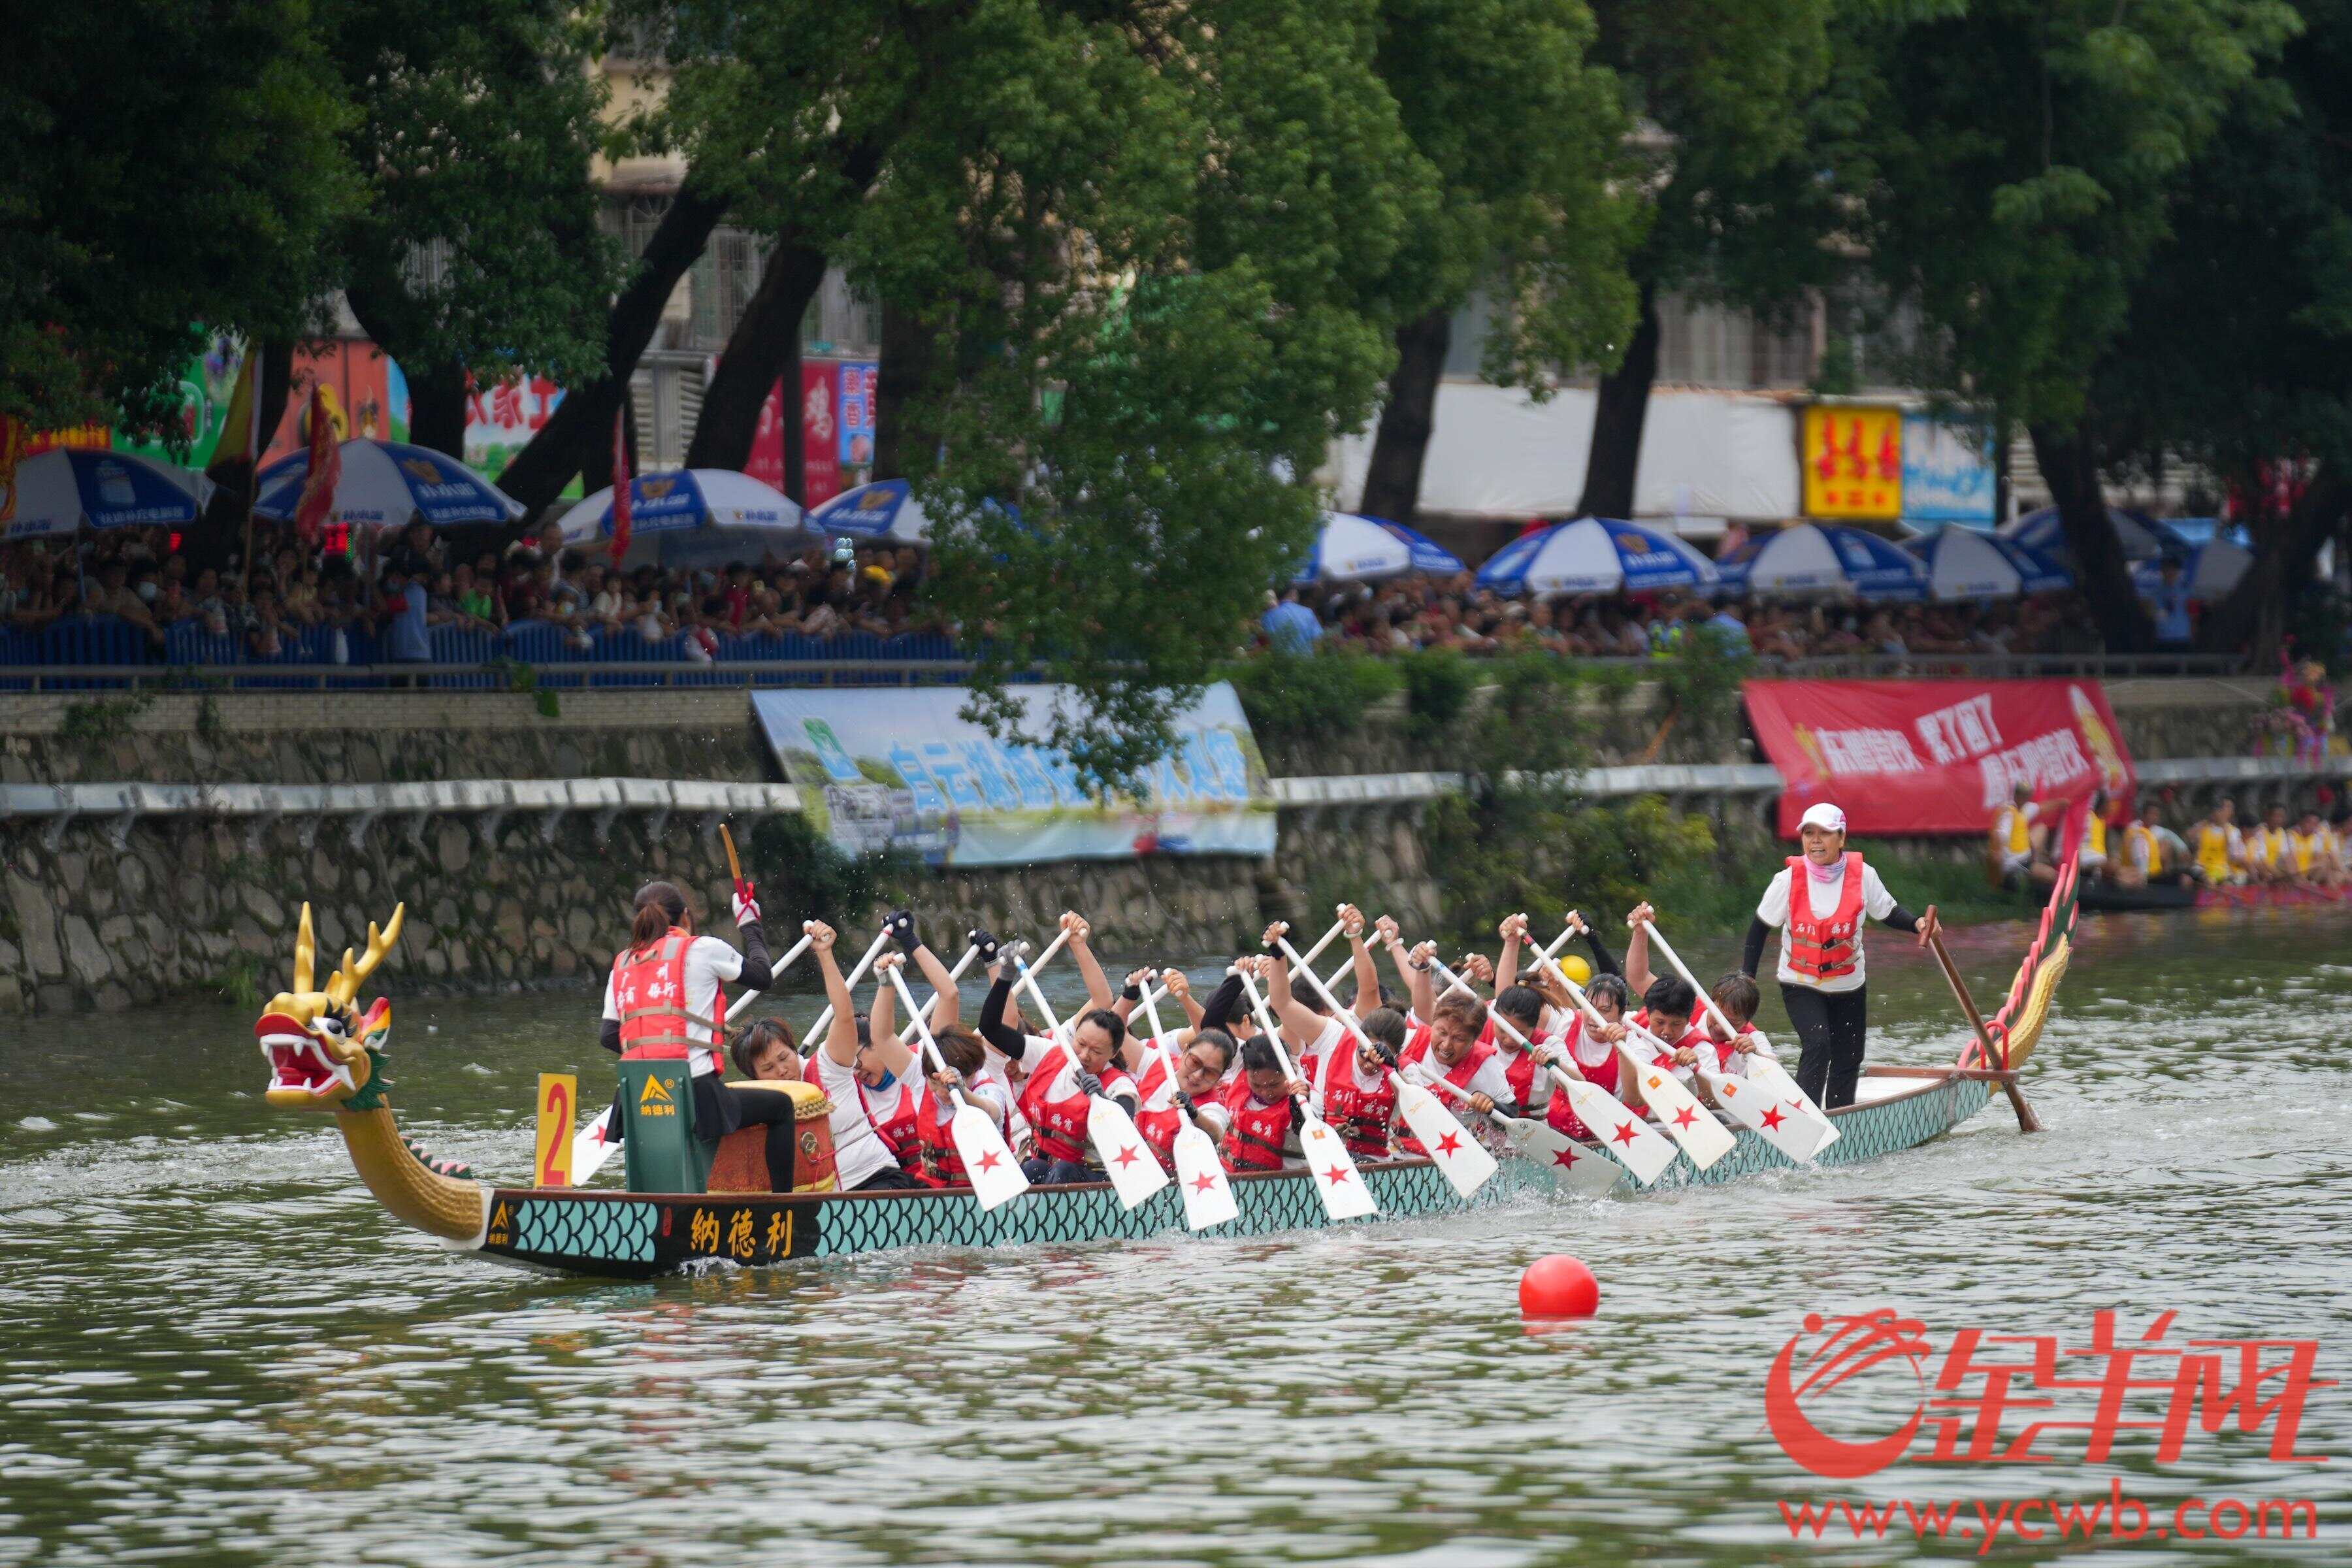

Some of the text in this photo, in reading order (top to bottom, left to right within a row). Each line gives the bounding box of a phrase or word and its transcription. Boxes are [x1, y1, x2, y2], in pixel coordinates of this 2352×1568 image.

[1816, 727, 1925, 776] 东鹏特饮
[1916, 693, 2003, 764] 累了困了
[544, 1082, 568, 1185] 2
